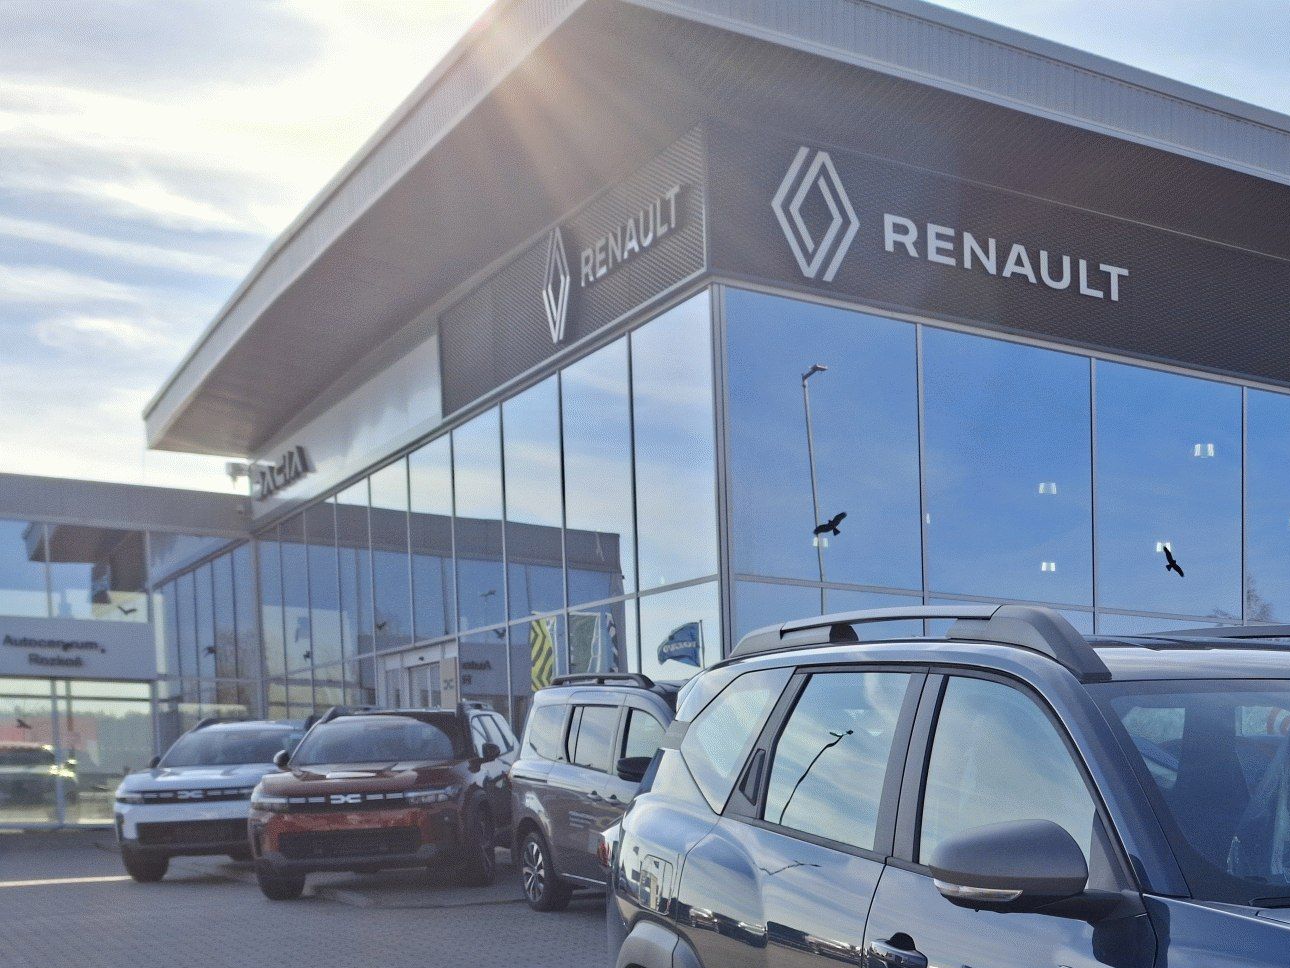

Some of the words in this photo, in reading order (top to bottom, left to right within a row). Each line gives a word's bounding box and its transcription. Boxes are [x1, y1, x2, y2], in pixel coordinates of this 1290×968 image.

[580, 185, 681, 287] RENAULT
[884, 213, 1129, 301] RENAULT
[3, 634, 99, 650] Autocenrum
